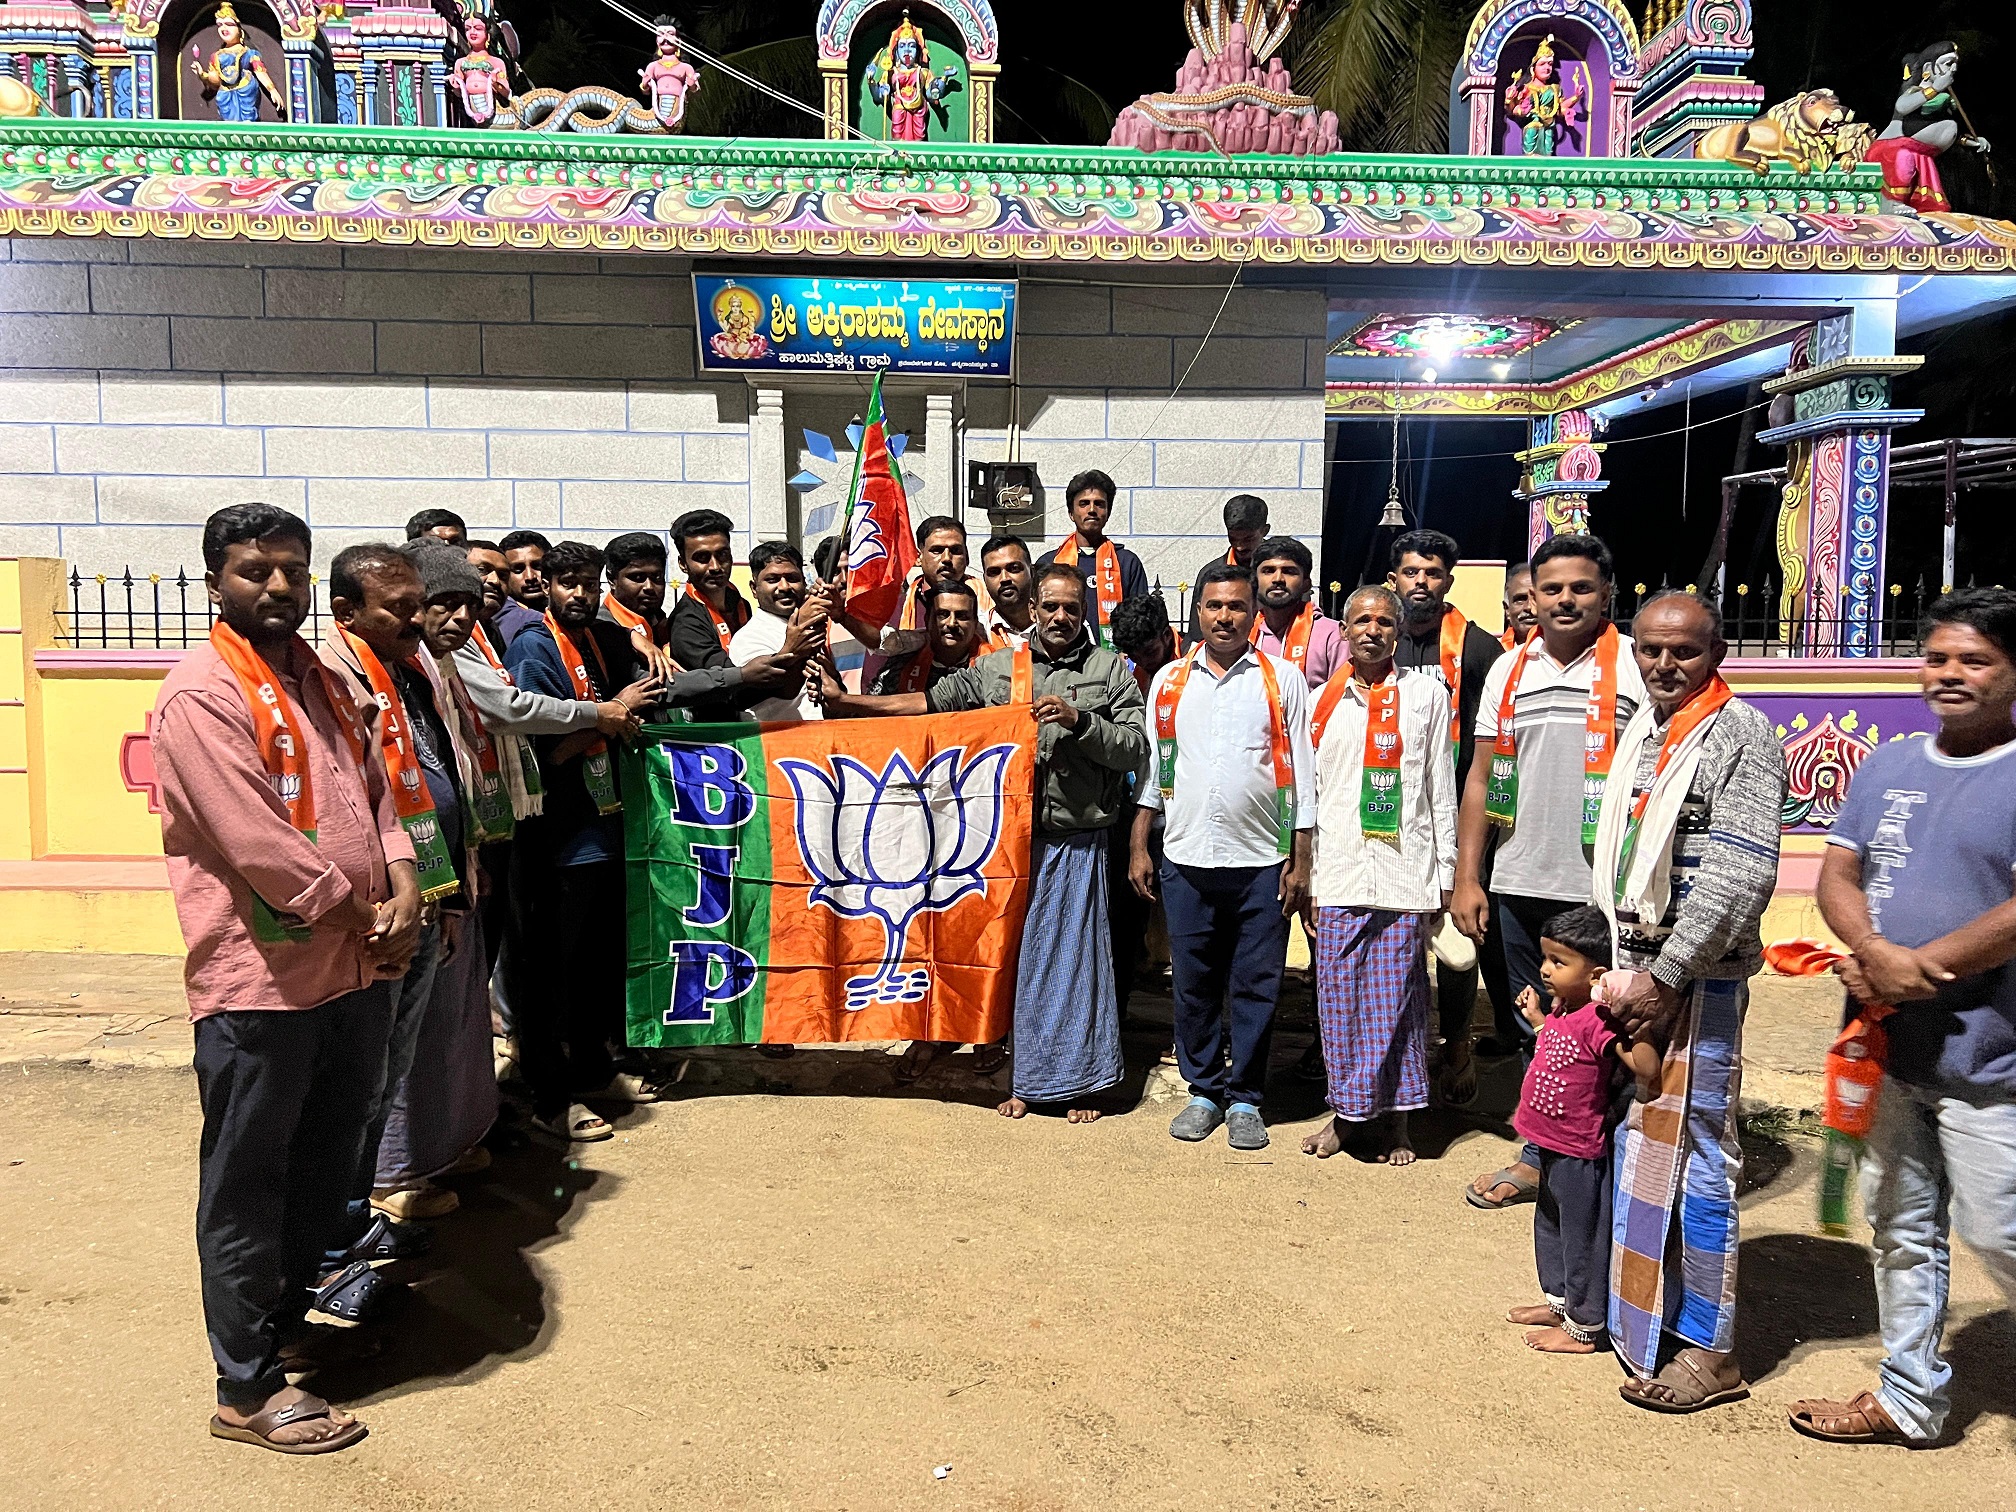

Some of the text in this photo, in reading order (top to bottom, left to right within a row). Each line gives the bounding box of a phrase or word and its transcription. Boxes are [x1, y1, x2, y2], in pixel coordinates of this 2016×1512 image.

[770, 293, 797, 343] ಶ್ರೀ
[918, 295, 1006, 353] ದೇವಸ್ಥಾನ
[860, 353, 891, 369] ಗ್ರಾಮ
[592, 786, 612, 799] BJP
[1488, 792, 1511, 804] BJP
[1367, 802, 1394, 813] BJP
[416, 856, 443, 873] BJP
[659, 740, 758, 1027] BJP
